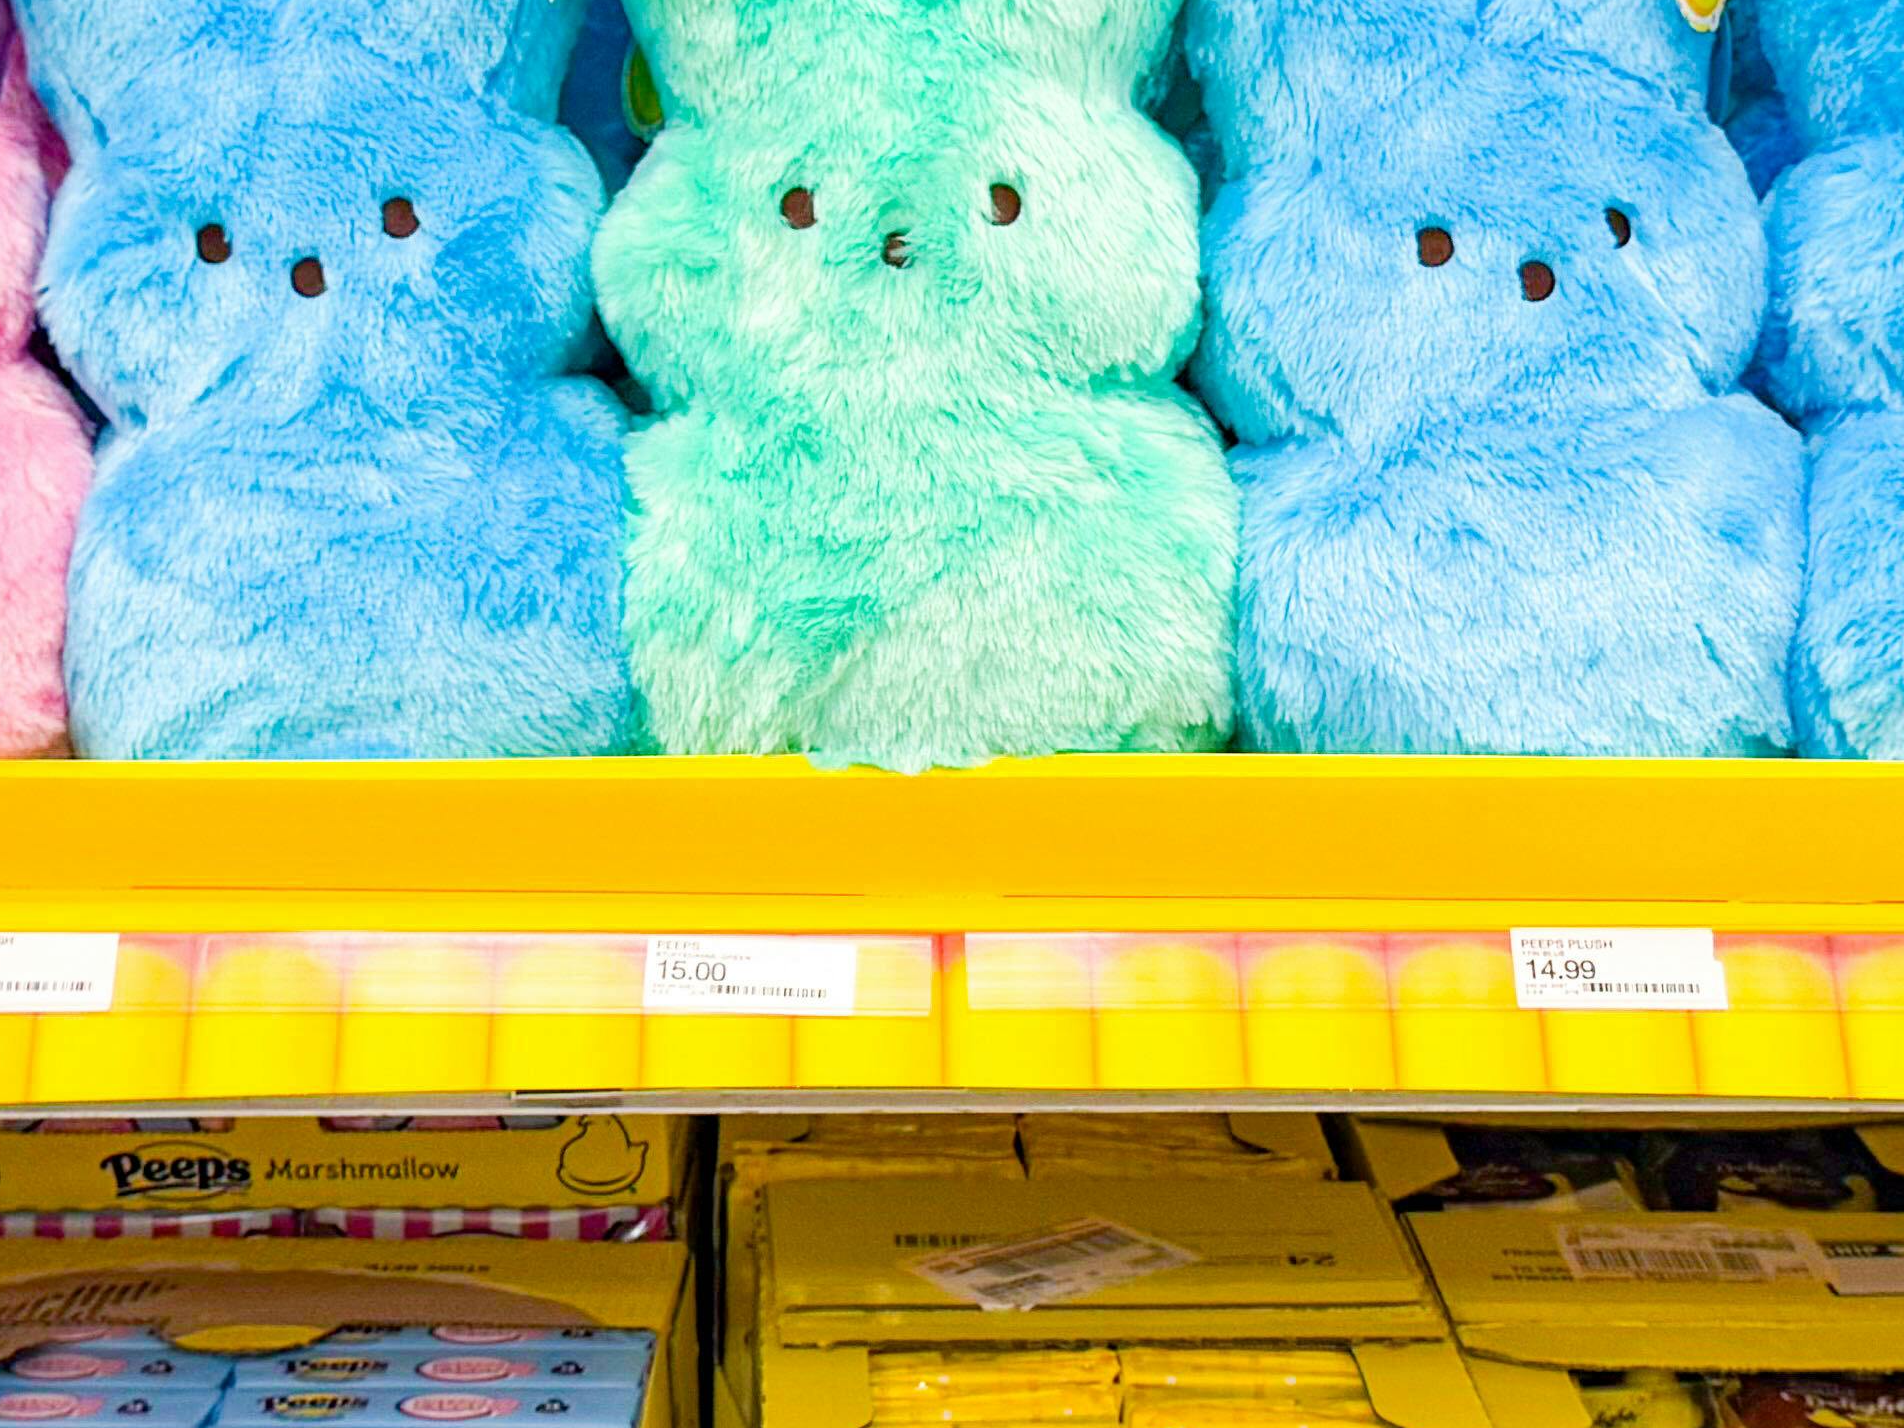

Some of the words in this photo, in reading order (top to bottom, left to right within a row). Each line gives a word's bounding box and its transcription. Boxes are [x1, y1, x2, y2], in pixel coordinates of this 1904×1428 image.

[1520, 939, 1564, 949] PEEPS
[1568, 939, 1613, 950] PLUSH
[657, 959, 727, 982] 15.00
[1526, 959, 1597, 980] 14.99
[100, 1150, 251, 1192] Peeps
[263, 1153, 459, 1183] Marshmallow
